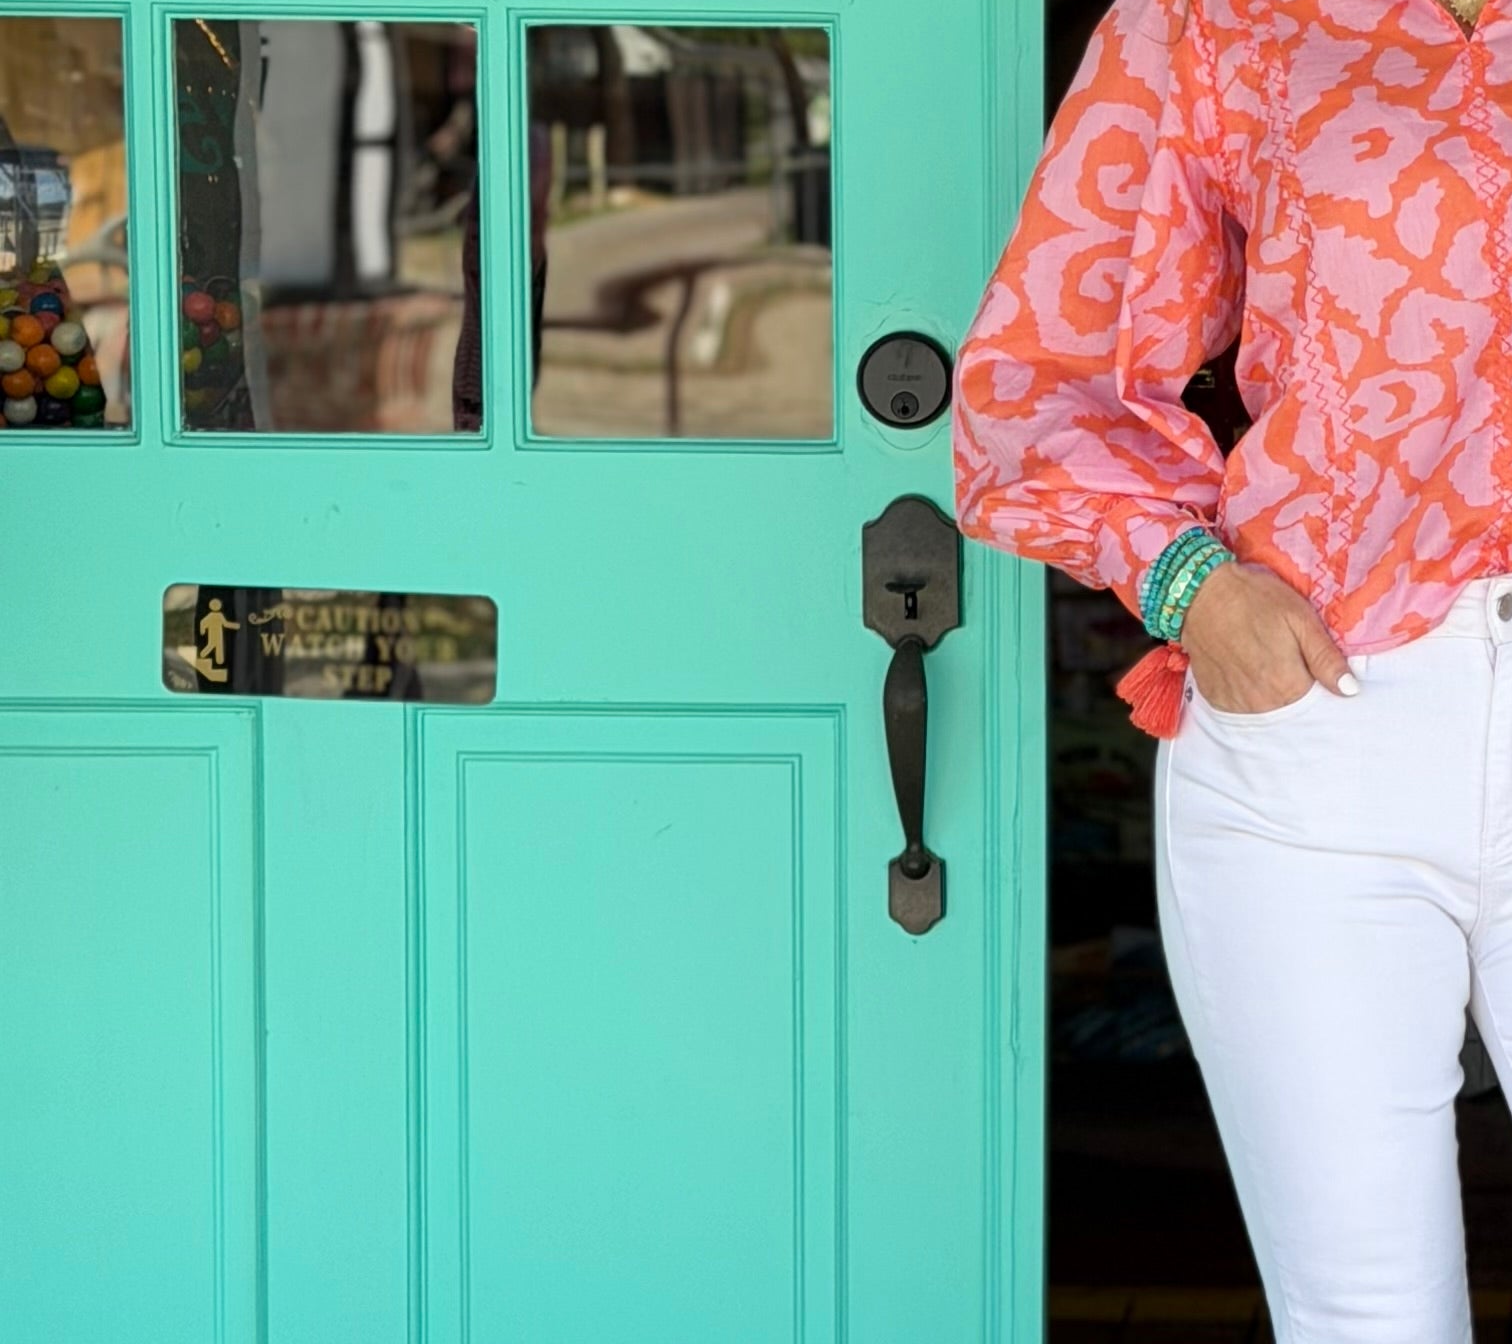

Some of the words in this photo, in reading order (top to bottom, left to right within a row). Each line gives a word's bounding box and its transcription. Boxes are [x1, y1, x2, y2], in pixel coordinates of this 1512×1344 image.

[297, 606, 420, 632] CAUTION
[260, 632, 365, 660] WATCH
[323, 664, 392, 693] STEP
